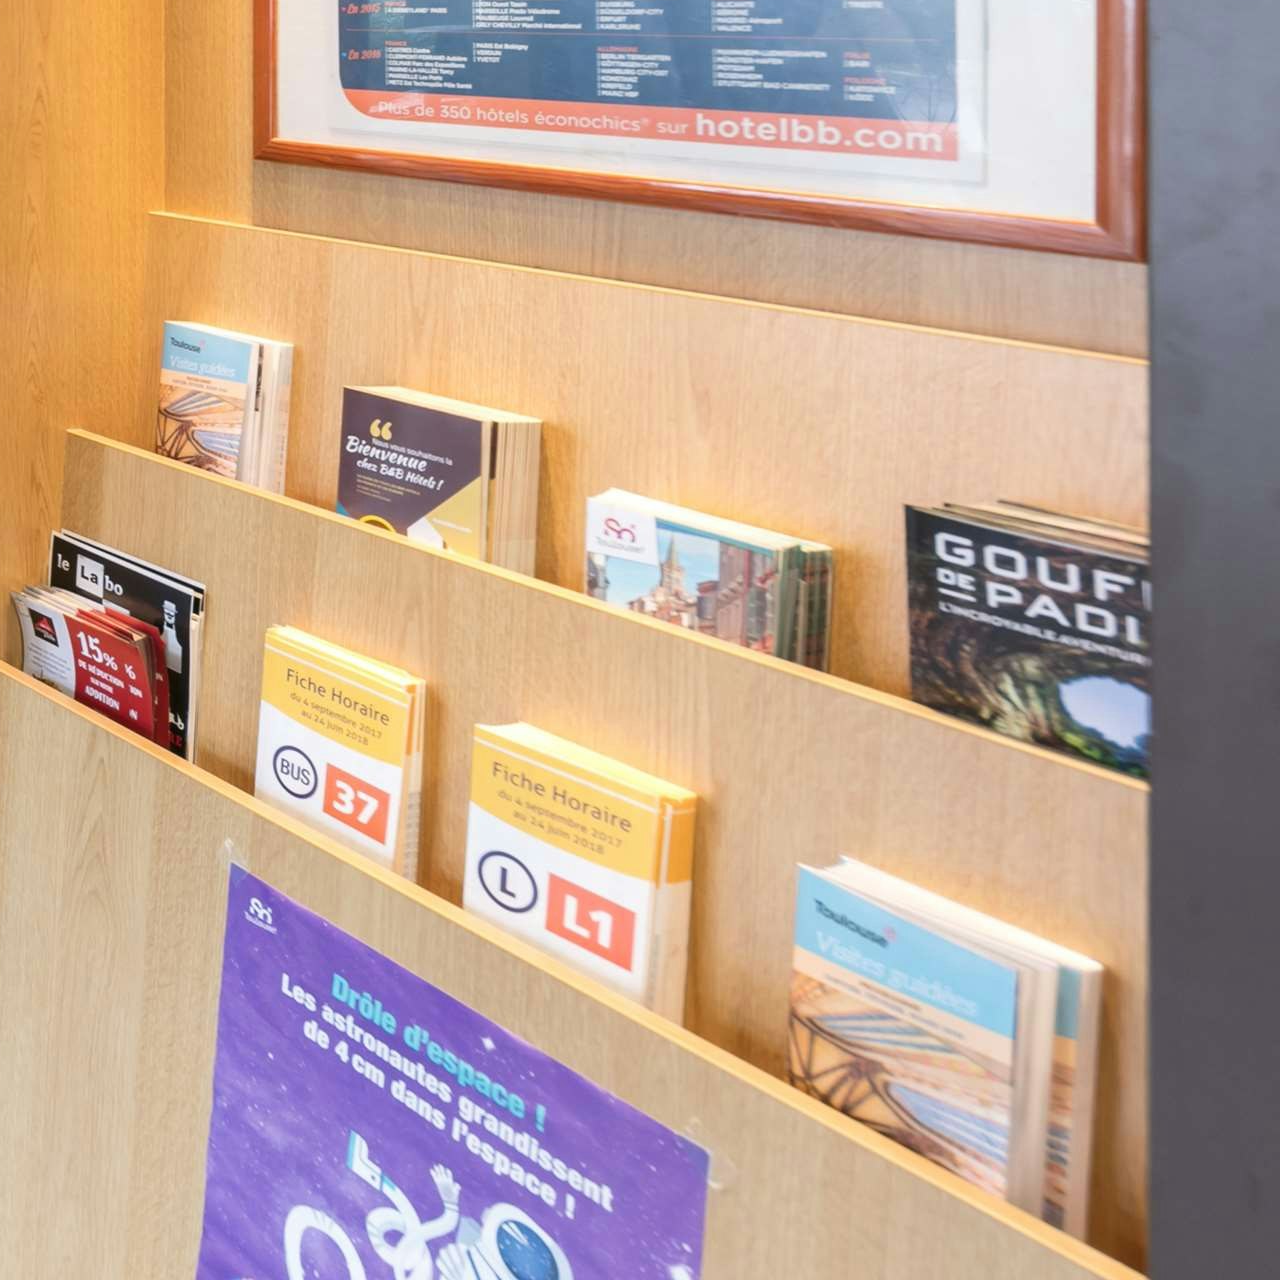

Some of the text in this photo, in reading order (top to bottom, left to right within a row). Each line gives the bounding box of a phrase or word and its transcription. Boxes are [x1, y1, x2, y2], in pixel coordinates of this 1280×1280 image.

[347, 3, 358, 14] En
[378, 101, 410, 116] Plus
[415, 105, 433, 118] de
[440, 104, 471, 120] 350
[477, 107, 528, 125] hôtels
[656, 121, 688, 135] sur
[695, 112, 944, 153] hotelbb.com
[171, 337, 201, 353] Toulouse
[346, 435, 428, 472] Bienvenue
[390, 441, 406, 453] vous
[356, 458, 378, 472] chez
[379, 463, 404, 480] B&B
[405, 472, 436, 489] Hôtels
[57, 552, 70, 571] le
[936, 567, 976, 592] DE
[76, 630, 119, 671] 15%
[85, 685, 120, 712] ADDITION
[286, 668, 390, 726] Fiche Horaire
[290, 692, 382, 739] du 4 septembre 2017
[301, 710, 369, 746] au 24 juin 2018
[280, 757, 379, 825] BUS 37
[492, 761, 633, 833] Fiche Horaire
[497, 790, 624, 849] du 4 septembre 2017
[513, 810, 605, 856] au 24 juin 2018
[499, 865, 614, 950] L L1
[814, 898, 889, 948] Toulouse
[331, 972, 547, 1133] Drôle d'espace !
[281, 972, 614, 1213] Les astronautes grandissent
[303, 1019, 576, 1220] de 4 cm dans l'espace !
